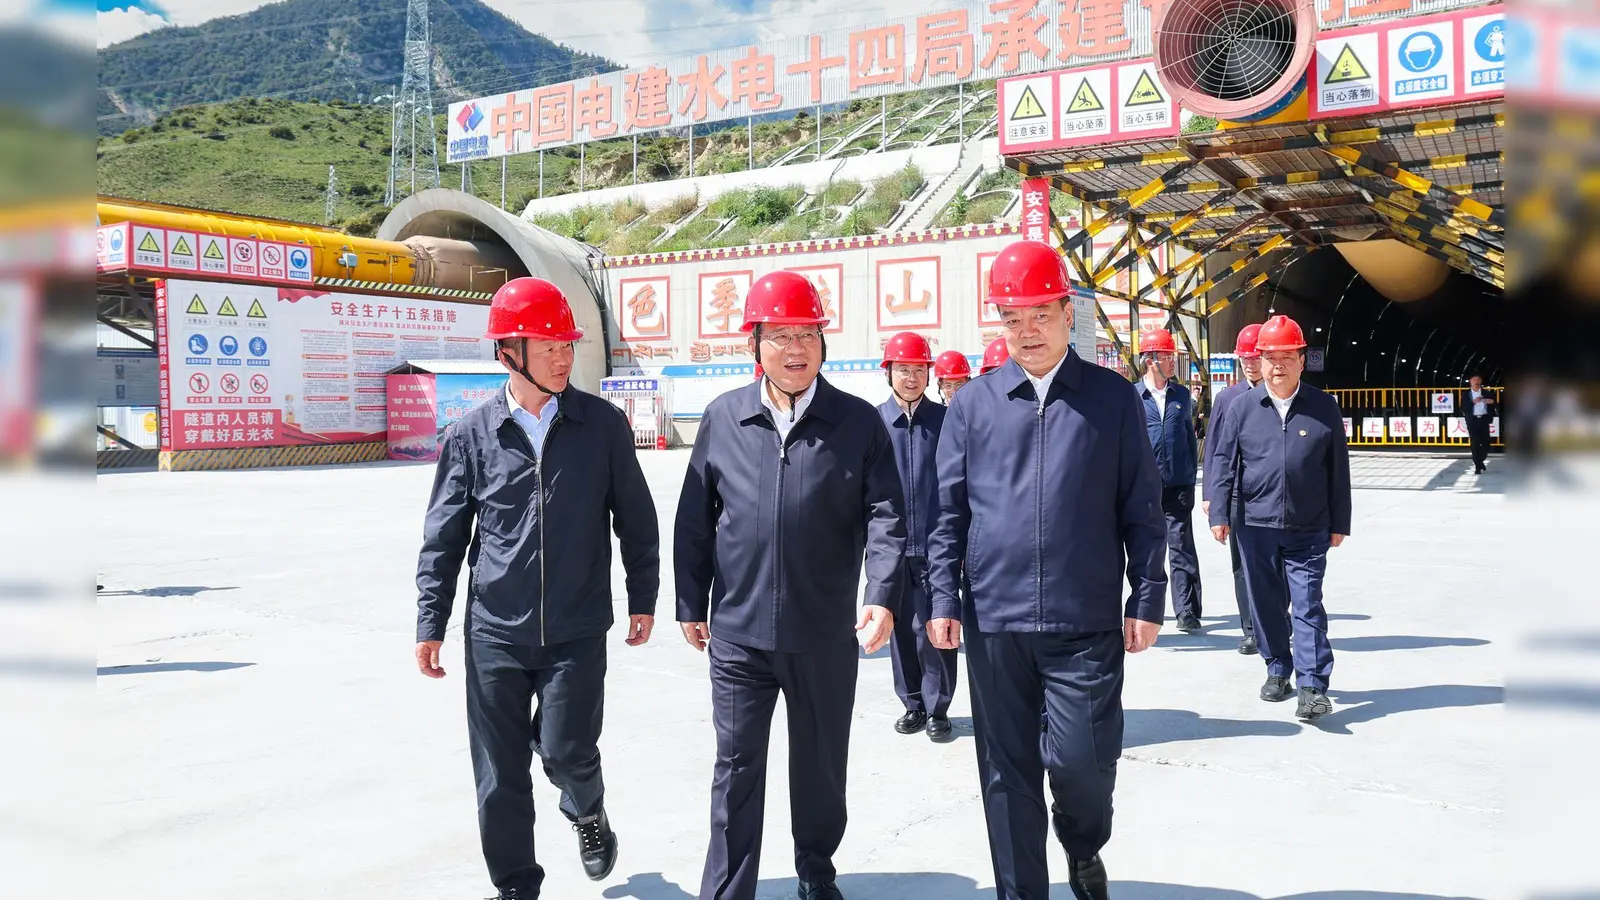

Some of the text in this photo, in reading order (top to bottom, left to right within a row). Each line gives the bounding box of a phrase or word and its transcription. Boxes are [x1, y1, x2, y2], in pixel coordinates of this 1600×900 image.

[1324, 88, 1372, 103] 当心落物
[1066, 119, 1105, 132] 当心坠落
[1124, 111, 1166, 125] 当心车辆
[1010, 126, 1048, 138] 注意安全
[330, 301, 457, 323] 安全生产十五条措施
[184, 411, 274, 427] 隧道内人员请
[184, 428, 274, 443] 穿戴好反光衣
